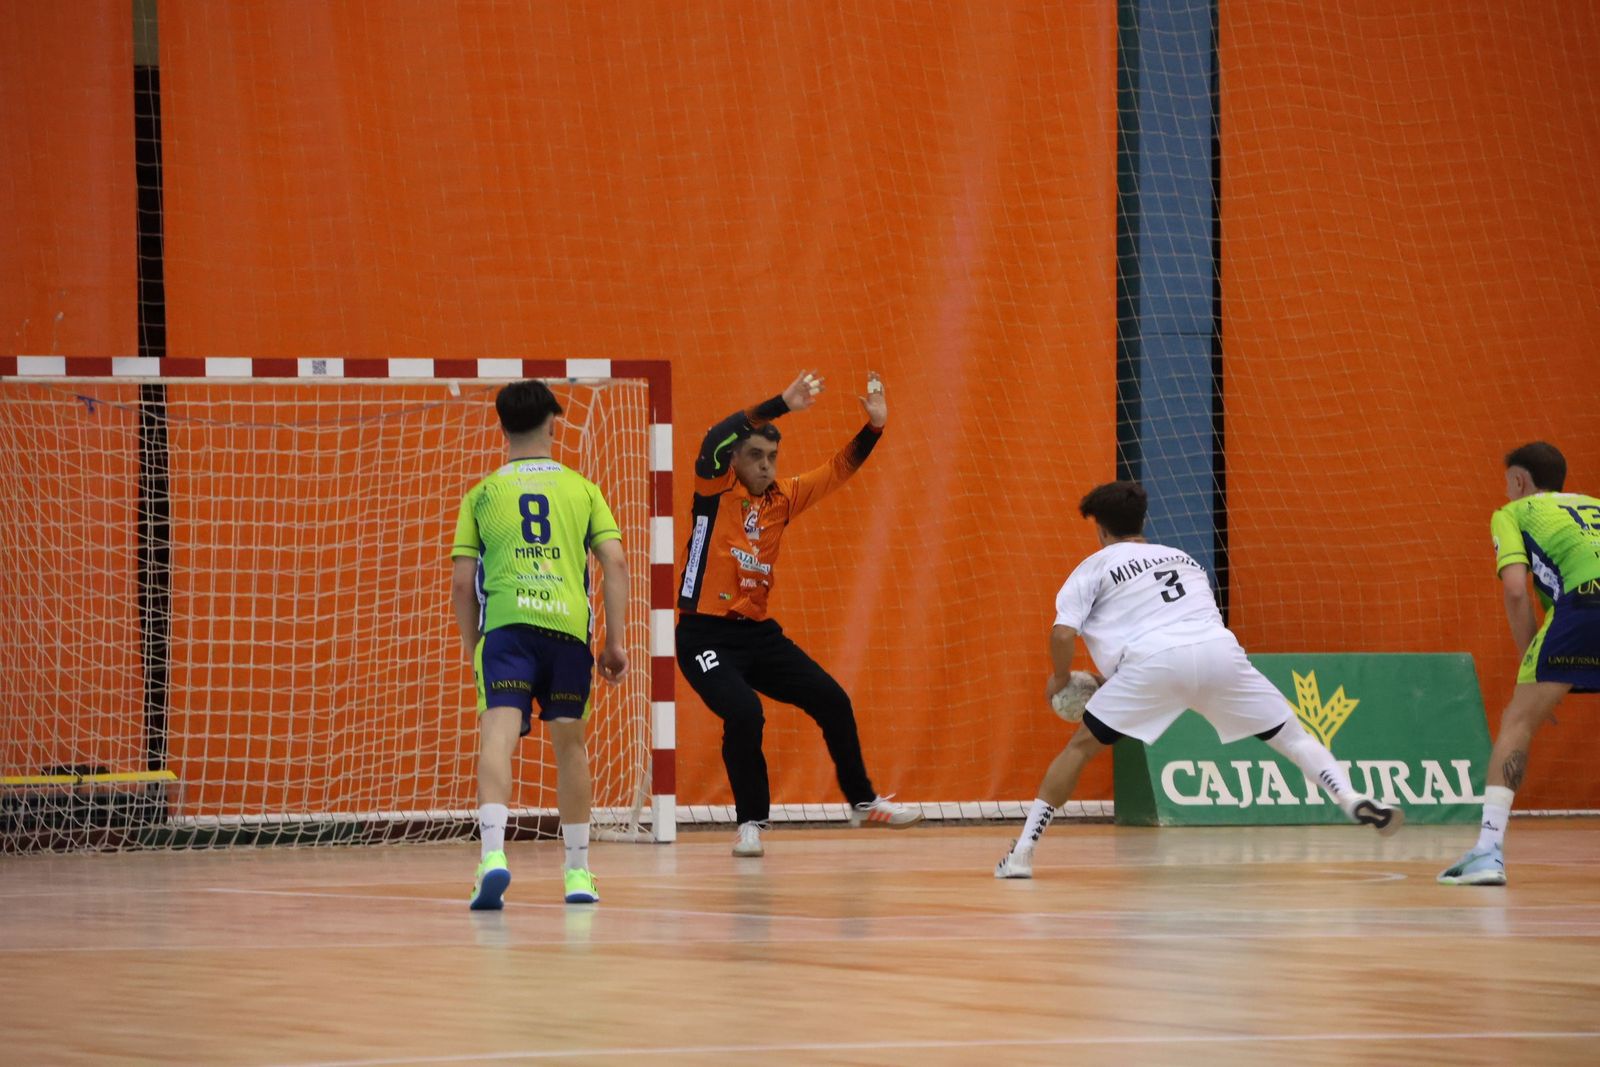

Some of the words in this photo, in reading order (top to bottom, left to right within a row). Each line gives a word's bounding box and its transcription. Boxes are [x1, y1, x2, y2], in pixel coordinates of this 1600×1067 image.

[518, 493, 550, 545] 8
[1557, 504, 1600, 530] 13
[515, 545, 561, 560] MARCO
[516, 588, 550, 601] PRO
[1153, 569, 1187, 603] 3
[695, 649, 720, 674] 12
[1161, 760, 1303, 808] CAJA
